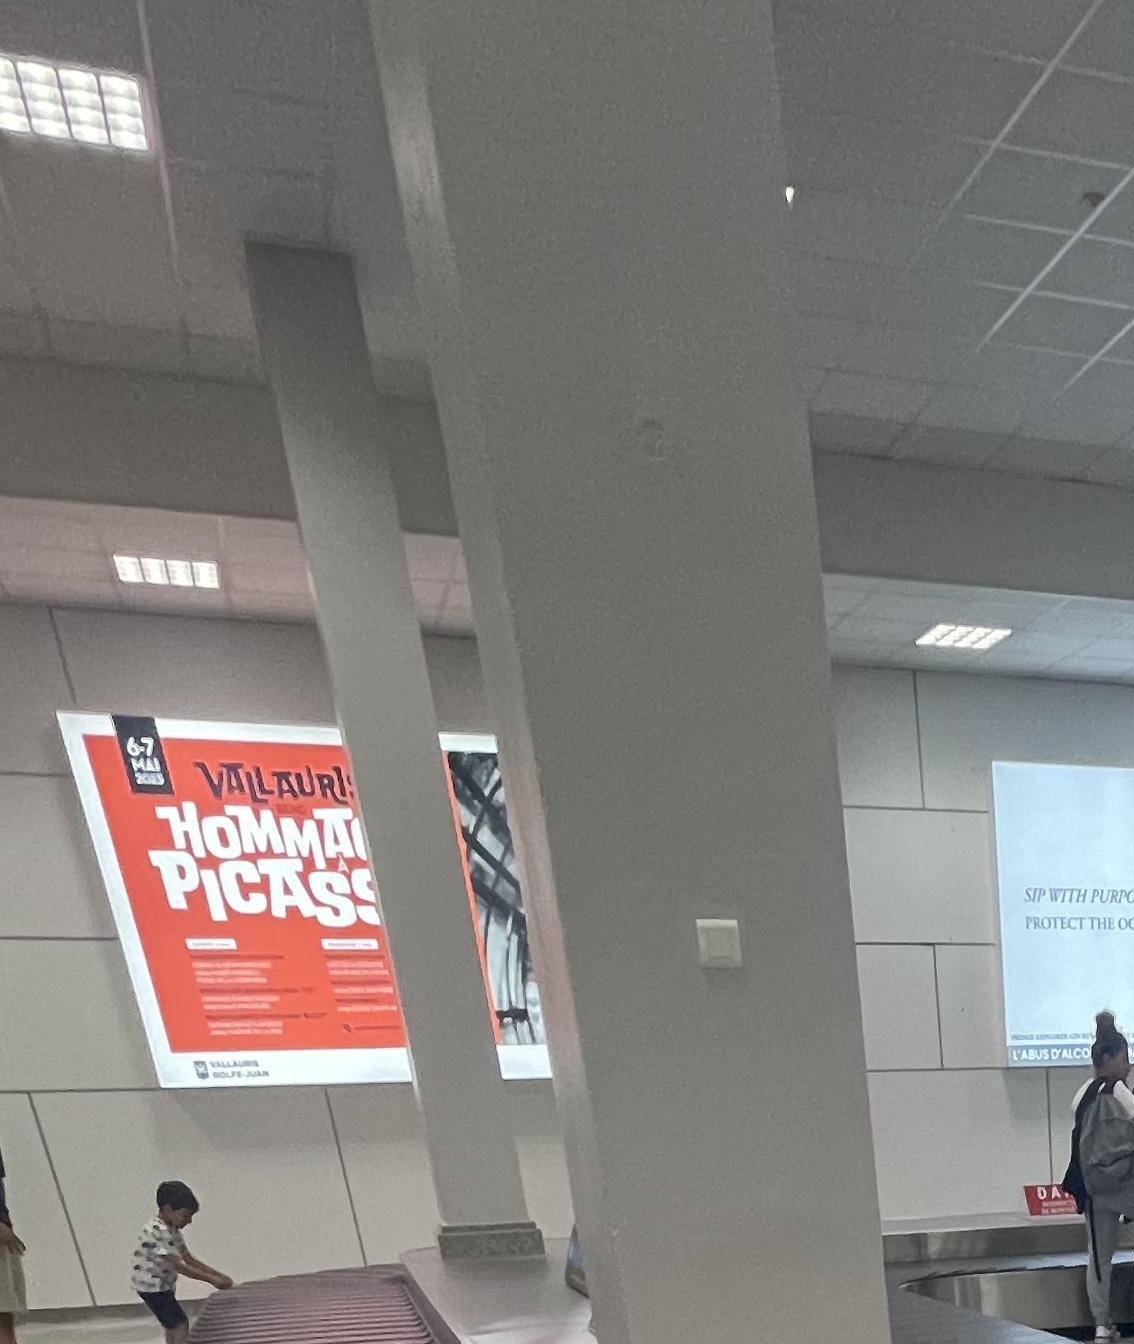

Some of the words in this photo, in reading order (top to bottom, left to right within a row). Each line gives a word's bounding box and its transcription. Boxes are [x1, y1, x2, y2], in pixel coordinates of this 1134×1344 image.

[127, 737, 154, 757] 6-7
[131, 757, 161, 772] MAI
[1024, 887, 1046, 903] SIP
[1049, 887, 1088, 904] WITH
[1025, 916, 1086, 930] PROTECT
[1088, 916, 1116, 930] THE
[1012, 1048, 1050, 1061] L'ABUS
